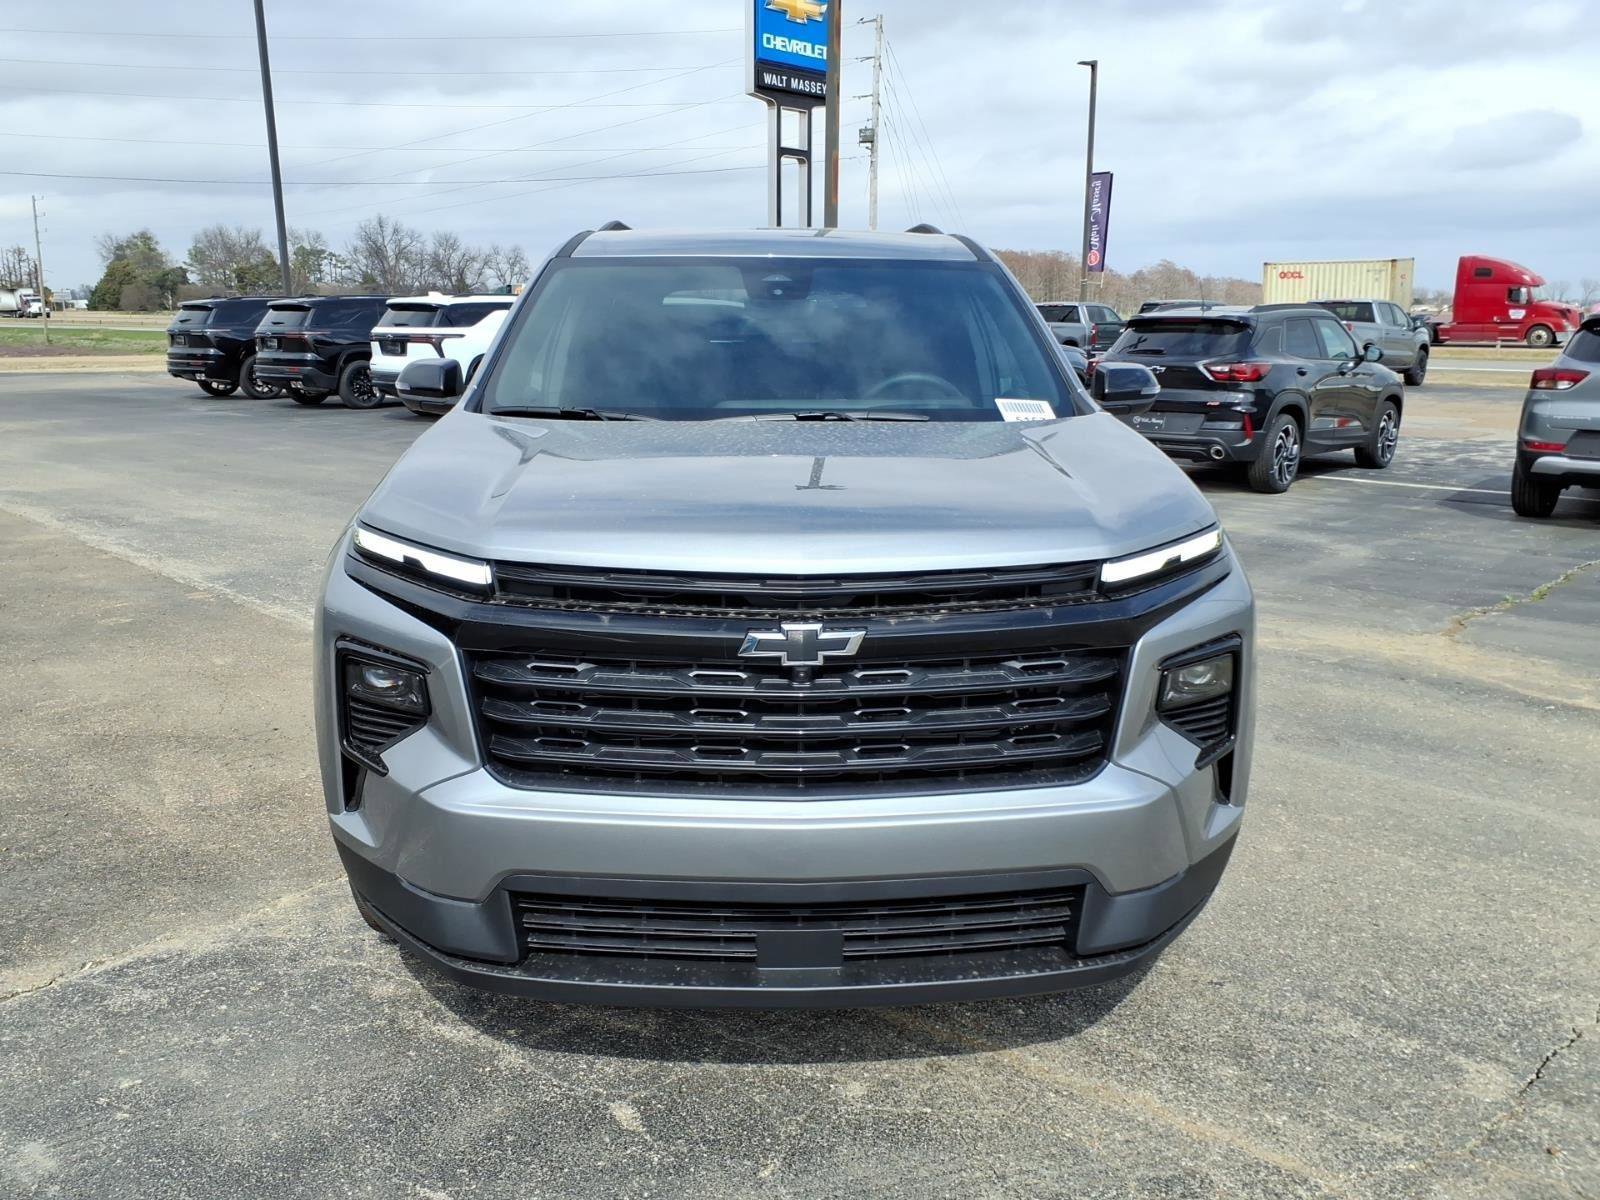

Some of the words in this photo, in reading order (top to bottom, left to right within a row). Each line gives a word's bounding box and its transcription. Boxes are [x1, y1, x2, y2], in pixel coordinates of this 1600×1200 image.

[763, 33, 827, 60] CHEVROLET
[763, 72, 787, 87] WALT
[791, 77, 827, 94] MASSEY
